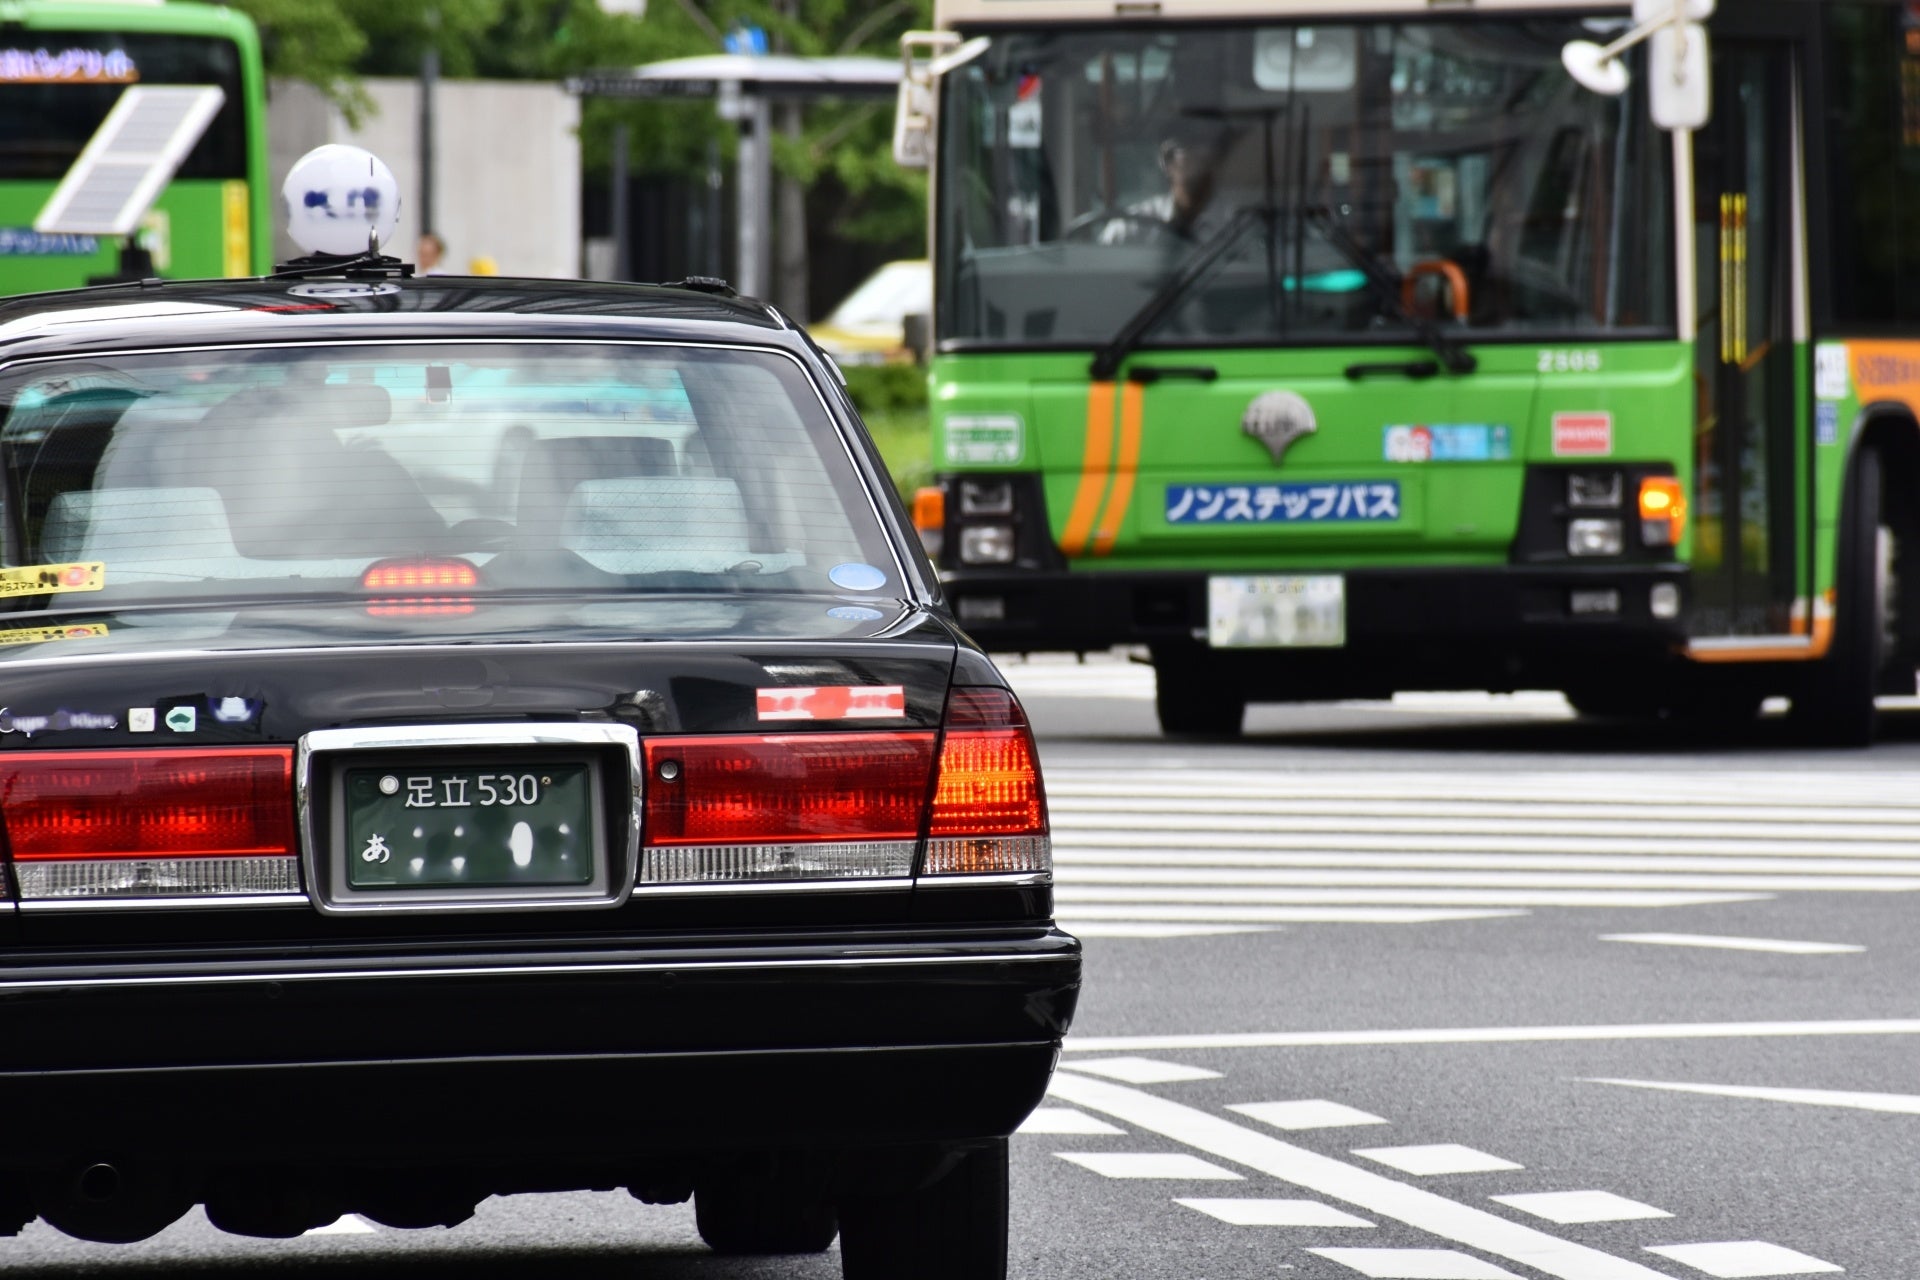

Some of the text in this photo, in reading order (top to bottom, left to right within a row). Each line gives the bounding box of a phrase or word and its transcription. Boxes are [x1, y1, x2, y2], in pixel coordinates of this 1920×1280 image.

[1166, 484, 1398, 521] ノンステップバス
[362, 833, 390, 863] あ
